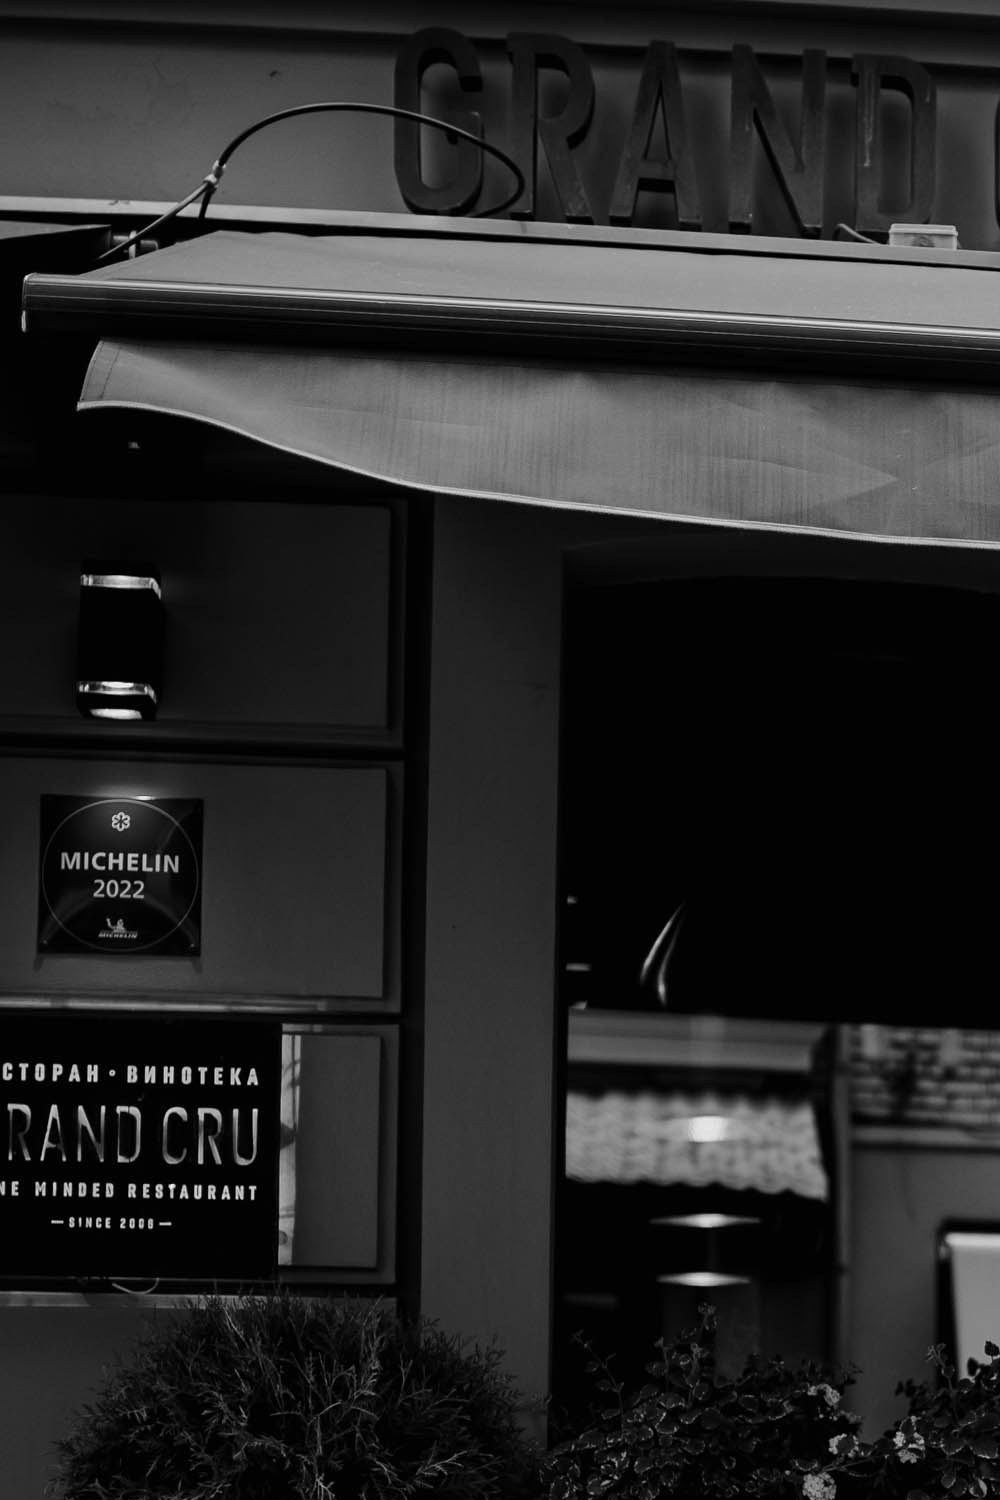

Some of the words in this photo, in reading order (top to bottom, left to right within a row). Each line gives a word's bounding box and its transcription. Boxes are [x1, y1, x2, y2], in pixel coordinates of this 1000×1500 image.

[394, 27, 937, 242] GRAND
[60, 851, 180, 873] MICHELIN
[92, 879, 145, 899] 2022
[1, 1062, 99, 1083] СТОРАН
[126, 1065, 259, 1086] ВИНОТЕКА
[7, 1103, 142, 1163] RAND
[162, 1106, 259, 1166] CRU
[34, 1181, 115, 1198] MINDED
[127, 1183, 257, 1201] RESTAURANT
[68, 1216, 112, 1229] SINCE
